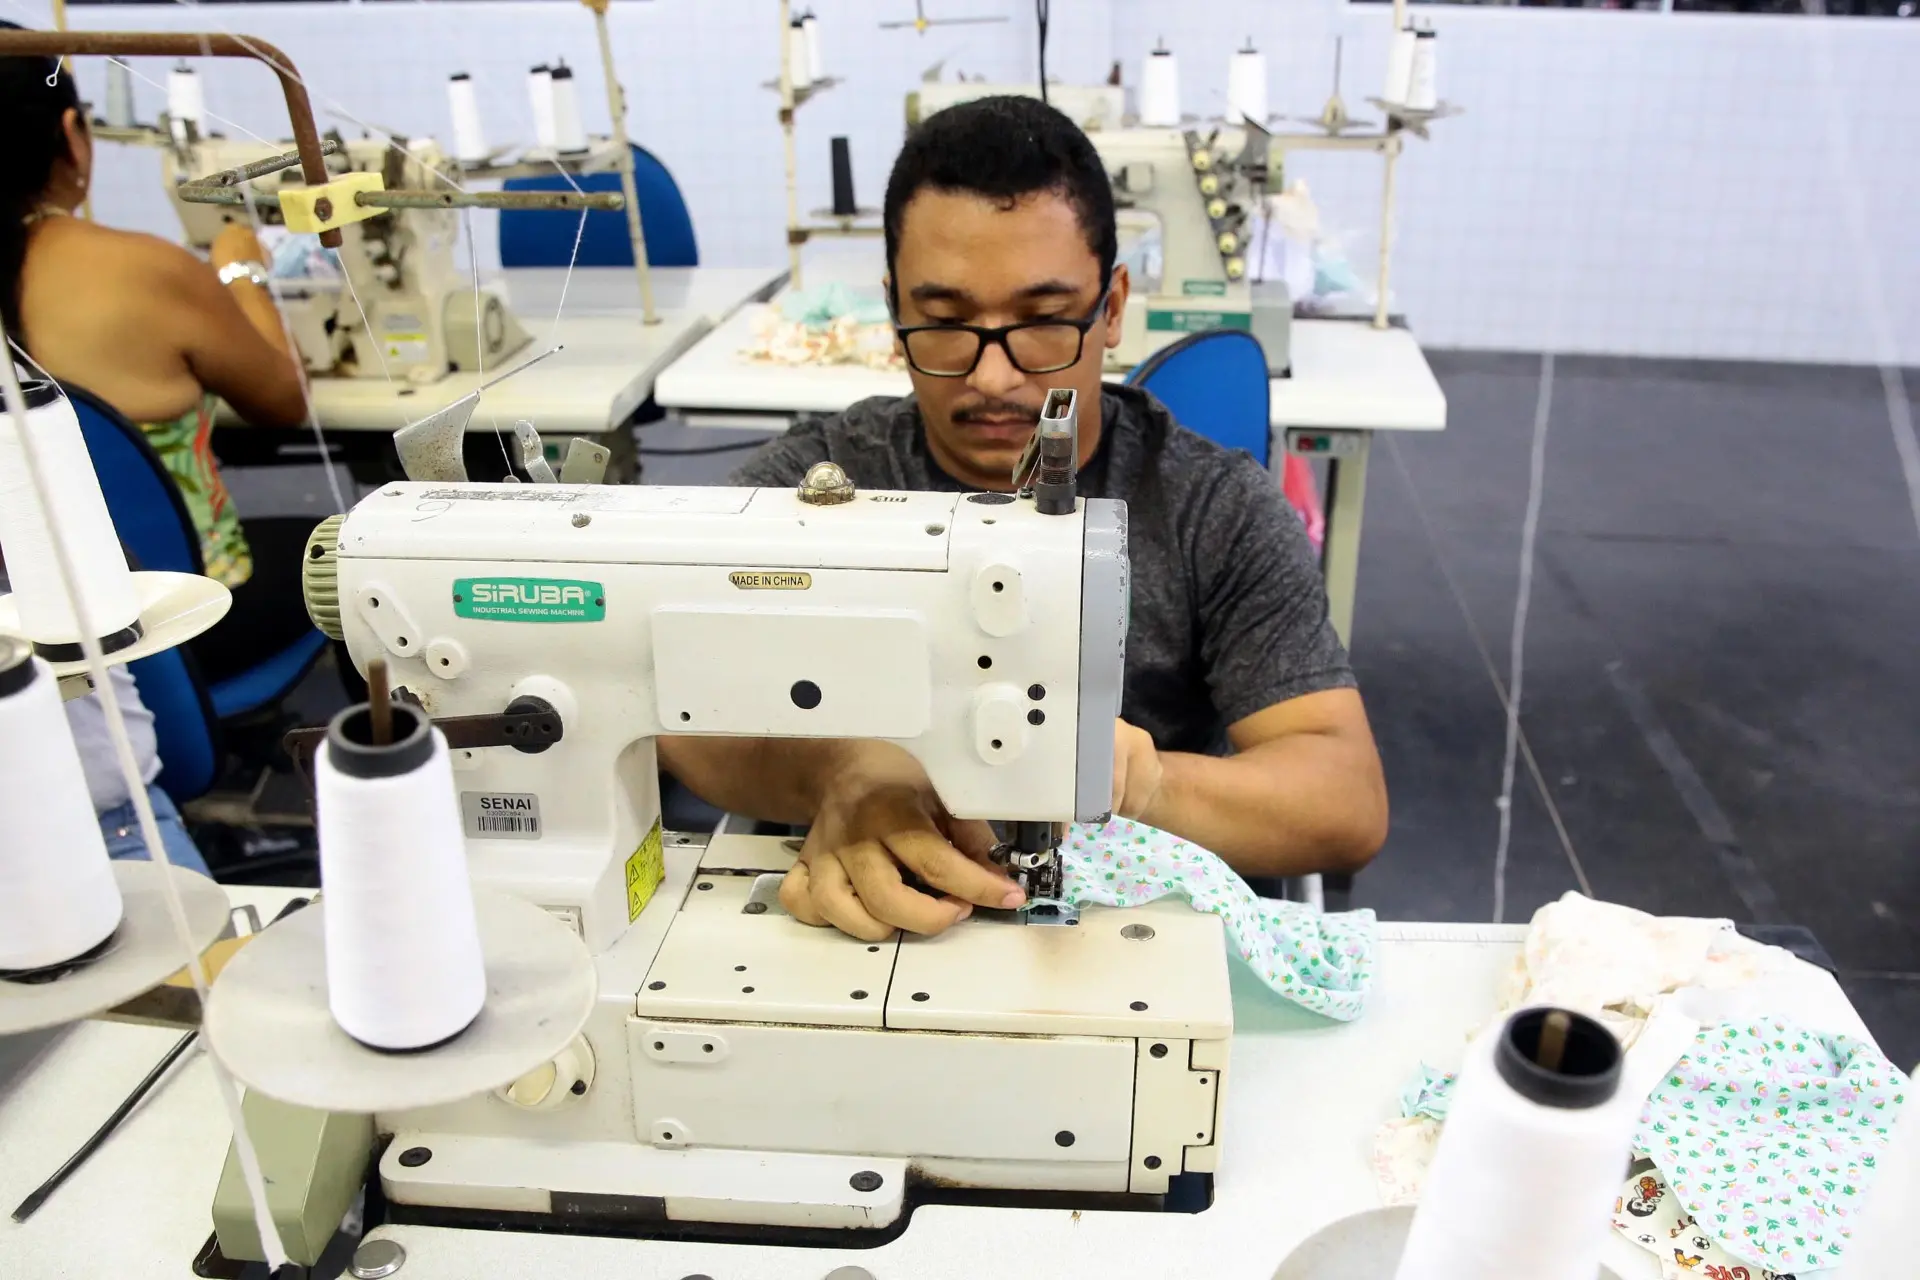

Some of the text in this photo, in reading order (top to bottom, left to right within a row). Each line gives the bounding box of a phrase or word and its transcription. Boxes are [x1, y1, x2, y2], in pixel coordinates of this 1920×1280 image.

[732, 576, 804, 586] MADE IN CHINA
[472, 606, 585, 617] INDUSTRIAL SEWING MACHINE
[480, 797, 532, 810] SENAI
